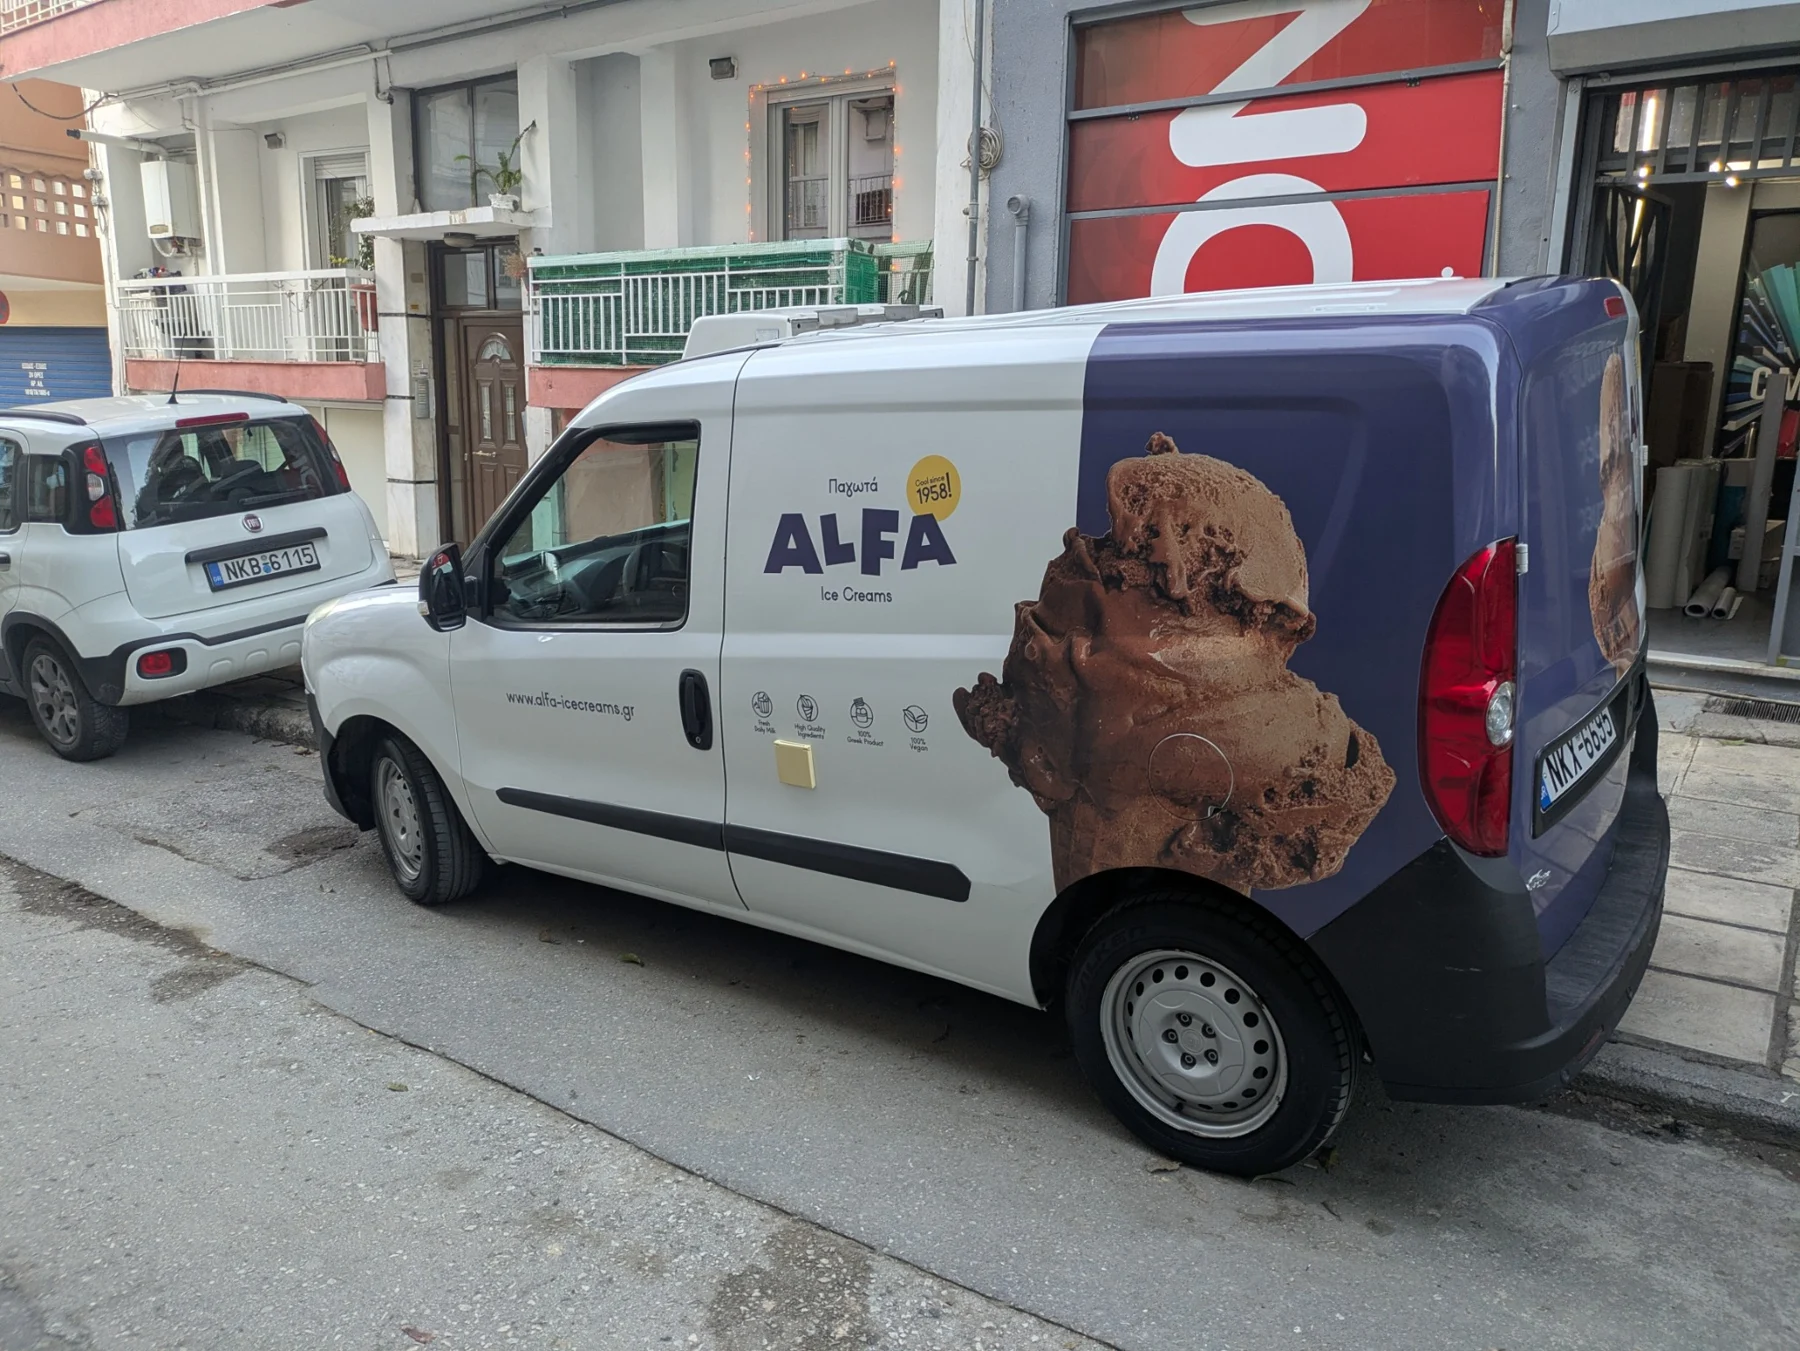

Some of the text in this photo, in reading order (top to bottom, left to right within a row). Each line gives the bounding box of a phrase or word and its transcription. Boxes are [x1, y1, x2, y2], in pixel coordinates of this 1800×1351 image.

[829, 476, 879, 498] Παγωτά
[915, 475, 945, 487] Cool since
[916, 472, 952, 504] 1958!
[763, 508, 957, 576] ALFA
[821, 586, 893, 602] Ice Creams
[505, 691, 635, 721] www.alfa-icecreams.gr
[863, 737, 884, 747] Product
[909, 743, 928, 753] Vegan
[910, 737, 926, 745] 100%
